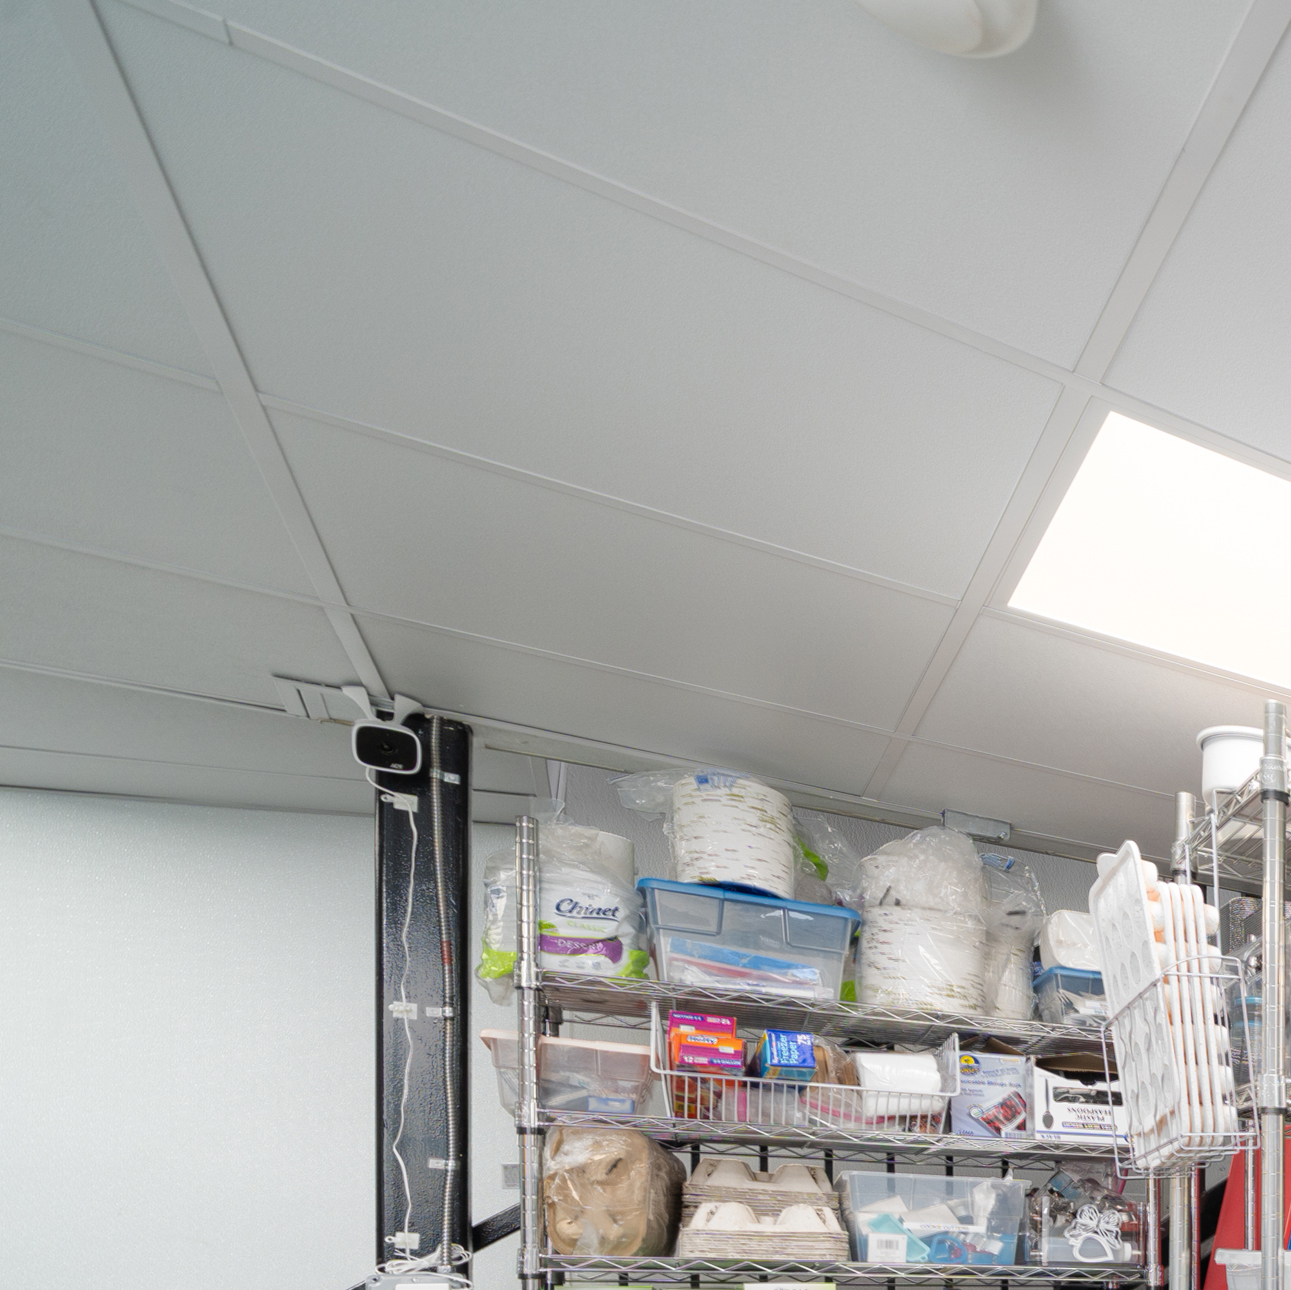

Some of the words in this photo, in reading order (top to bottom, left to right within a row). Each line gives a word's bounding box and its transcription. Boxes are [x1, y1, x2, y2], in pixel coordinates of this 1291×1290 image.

[554, 897, 620, 919] Chinet
[566, 920, 607, 933] CLASSIC
[779, 1033, 789, 1064] Freezer
[797, 1034, 807, 1045] 75
[788, 1040, 799, 1064] Paper
